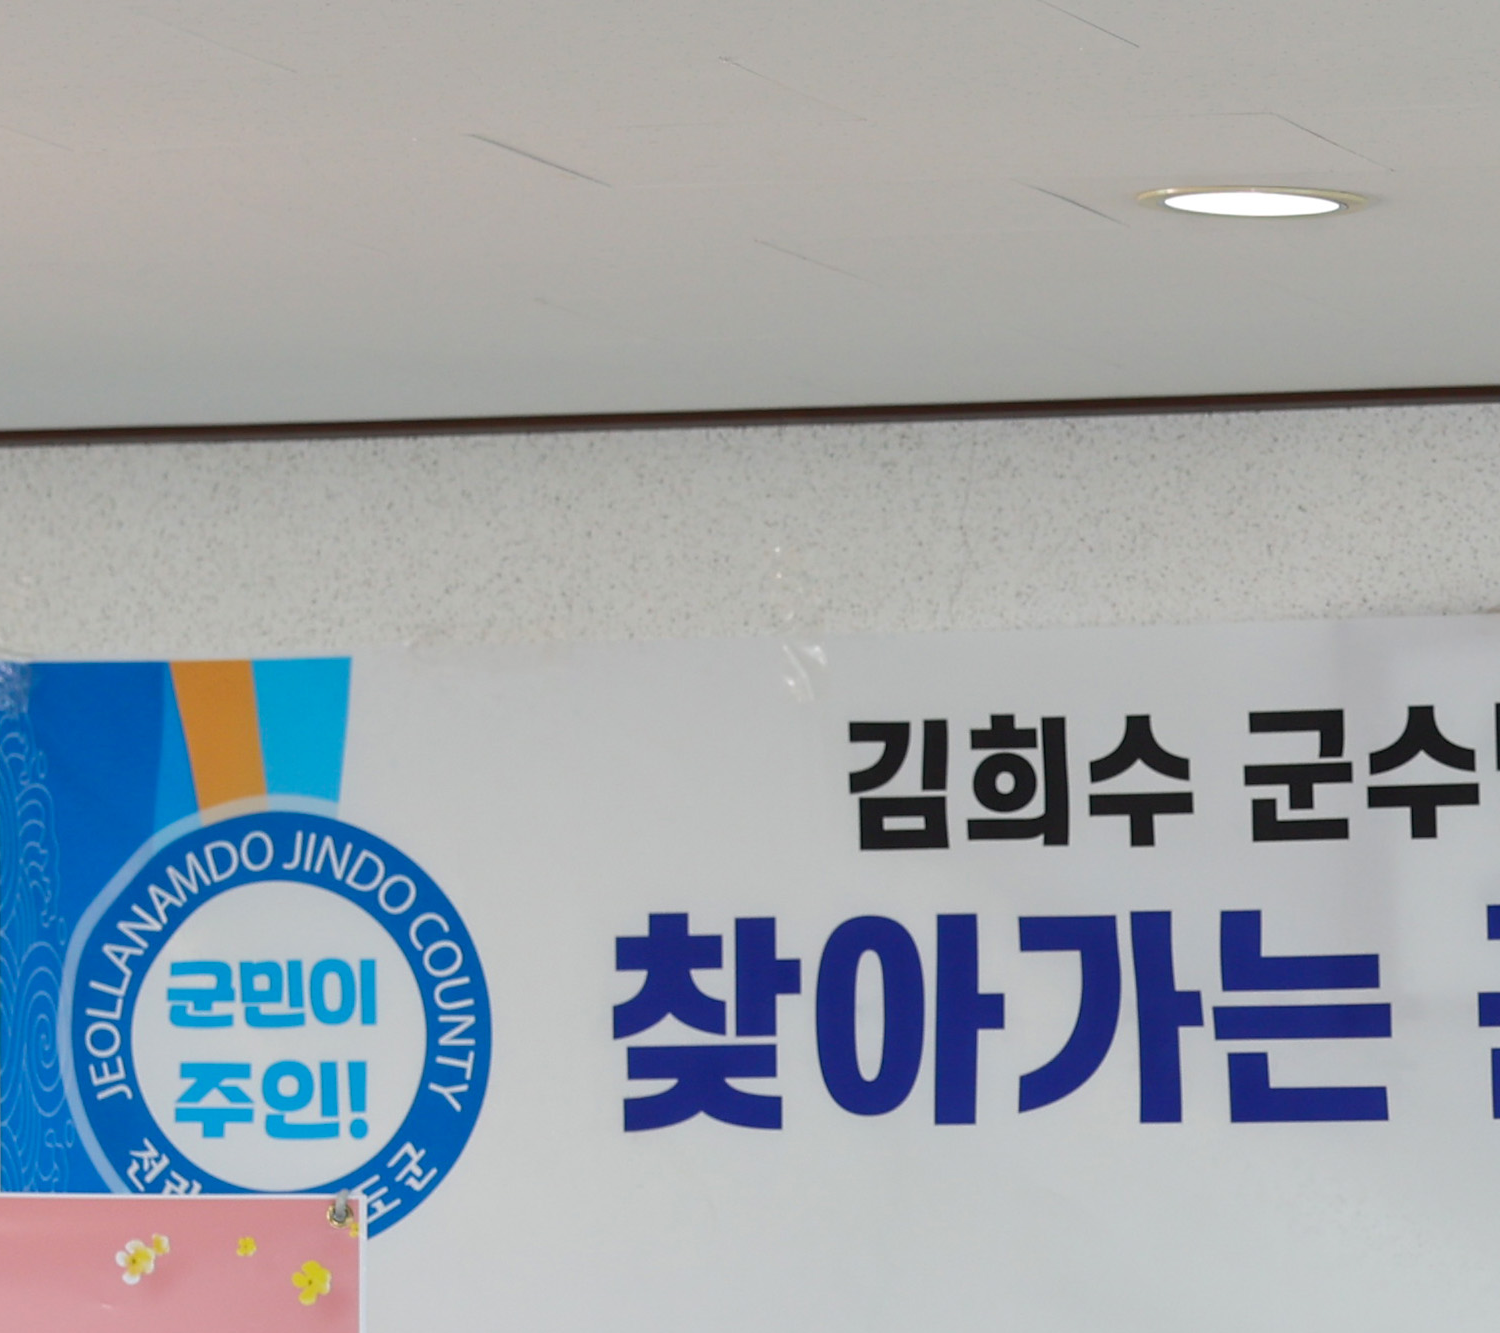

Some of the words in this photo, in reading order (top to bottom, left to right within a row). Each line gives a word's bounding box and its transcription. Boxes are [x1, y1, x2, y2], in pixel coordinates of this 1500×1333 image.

[848, 714, 1194, 851] 김희수
[85, 830, 274, 1101] JEOLLANAMDO
[282, 830, 417, 915] JINDO
[408, 912, 476, 1112] COUNTY
[166, 957, 378, 1029] 군민이
[612, 909, 1392, 1132] 찾아가는
[174, 1060, 369, 1139] 주인!
